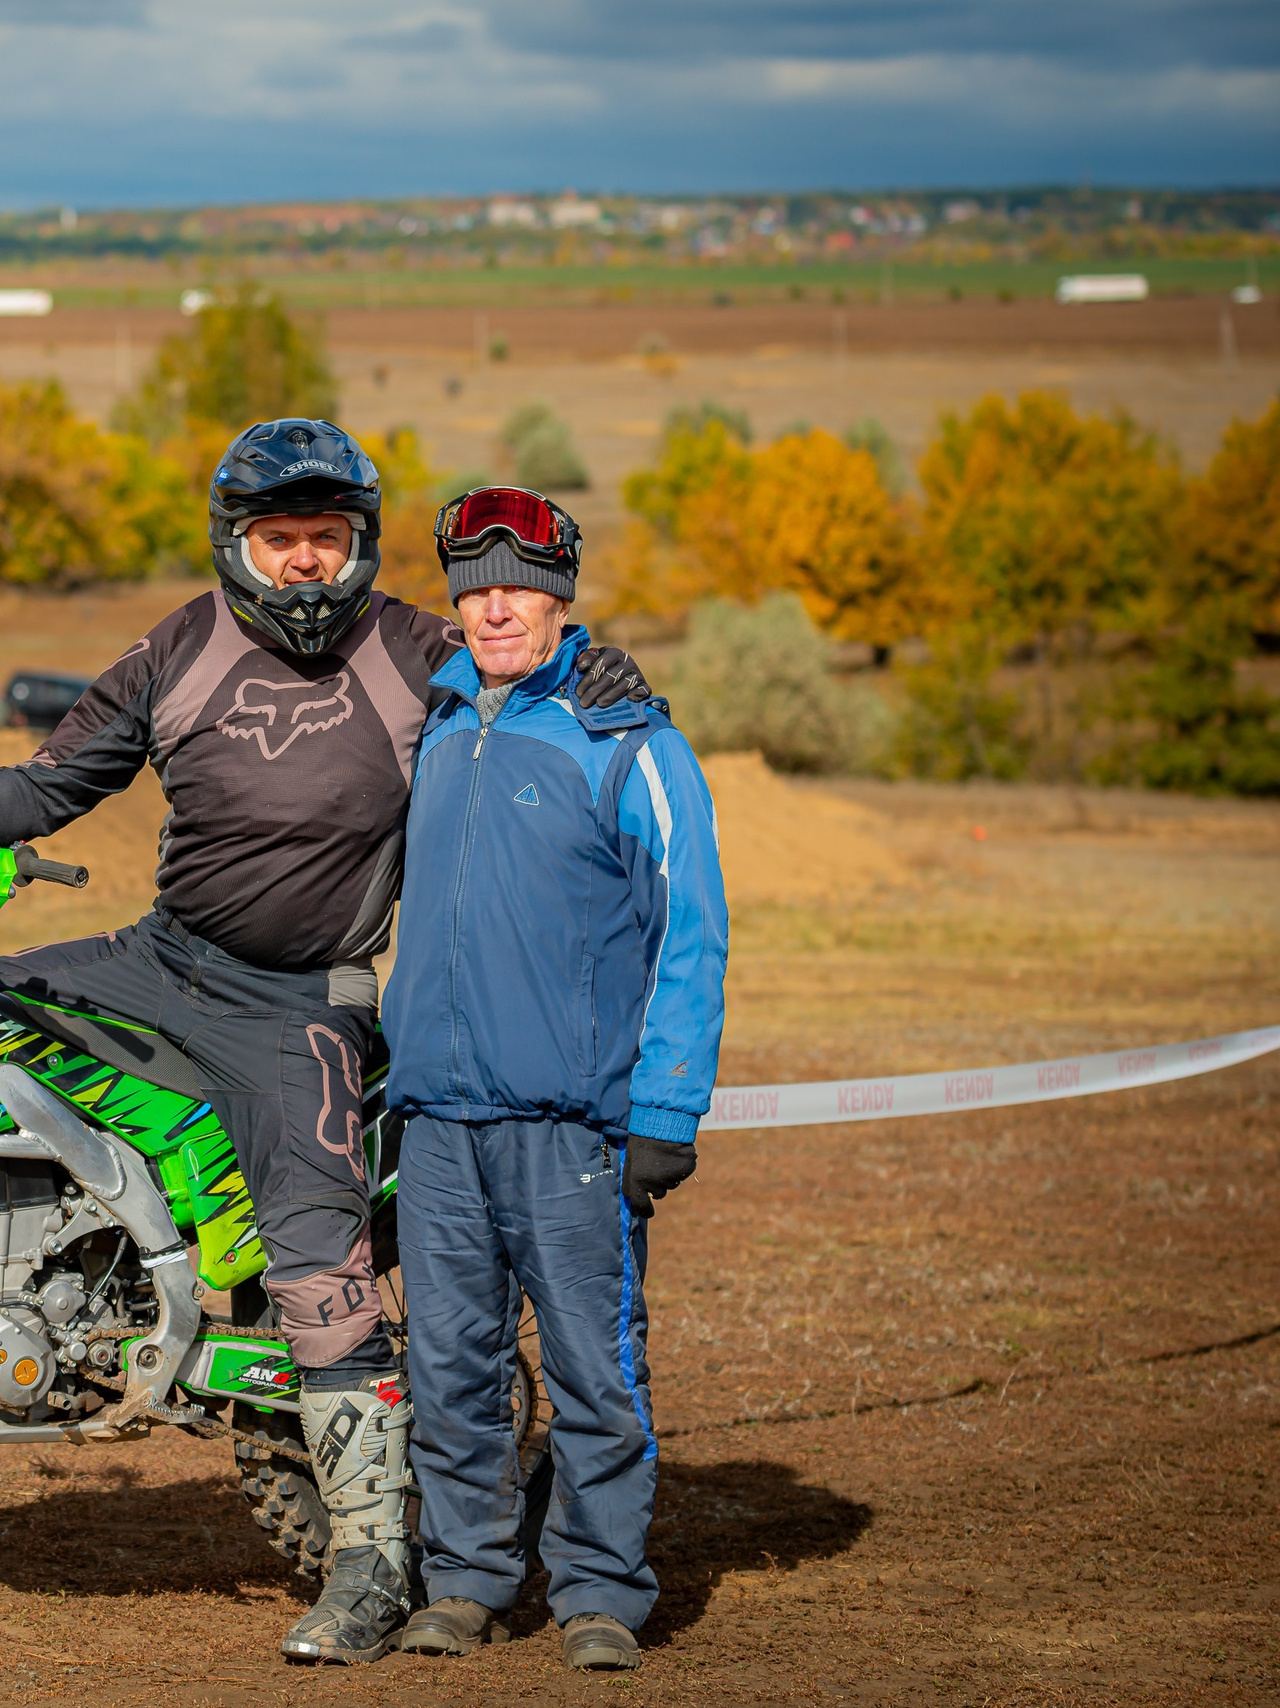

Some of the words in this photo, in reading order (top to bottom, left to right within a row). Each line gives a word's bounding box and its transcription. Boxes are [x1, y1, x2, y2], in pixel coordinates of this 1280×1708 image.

[289, 460, 334, 475] SHOEI
[243, 1366, 291, 1385] ANG
[238, 1377, 290, 1391] MOTOGRAPHICS
